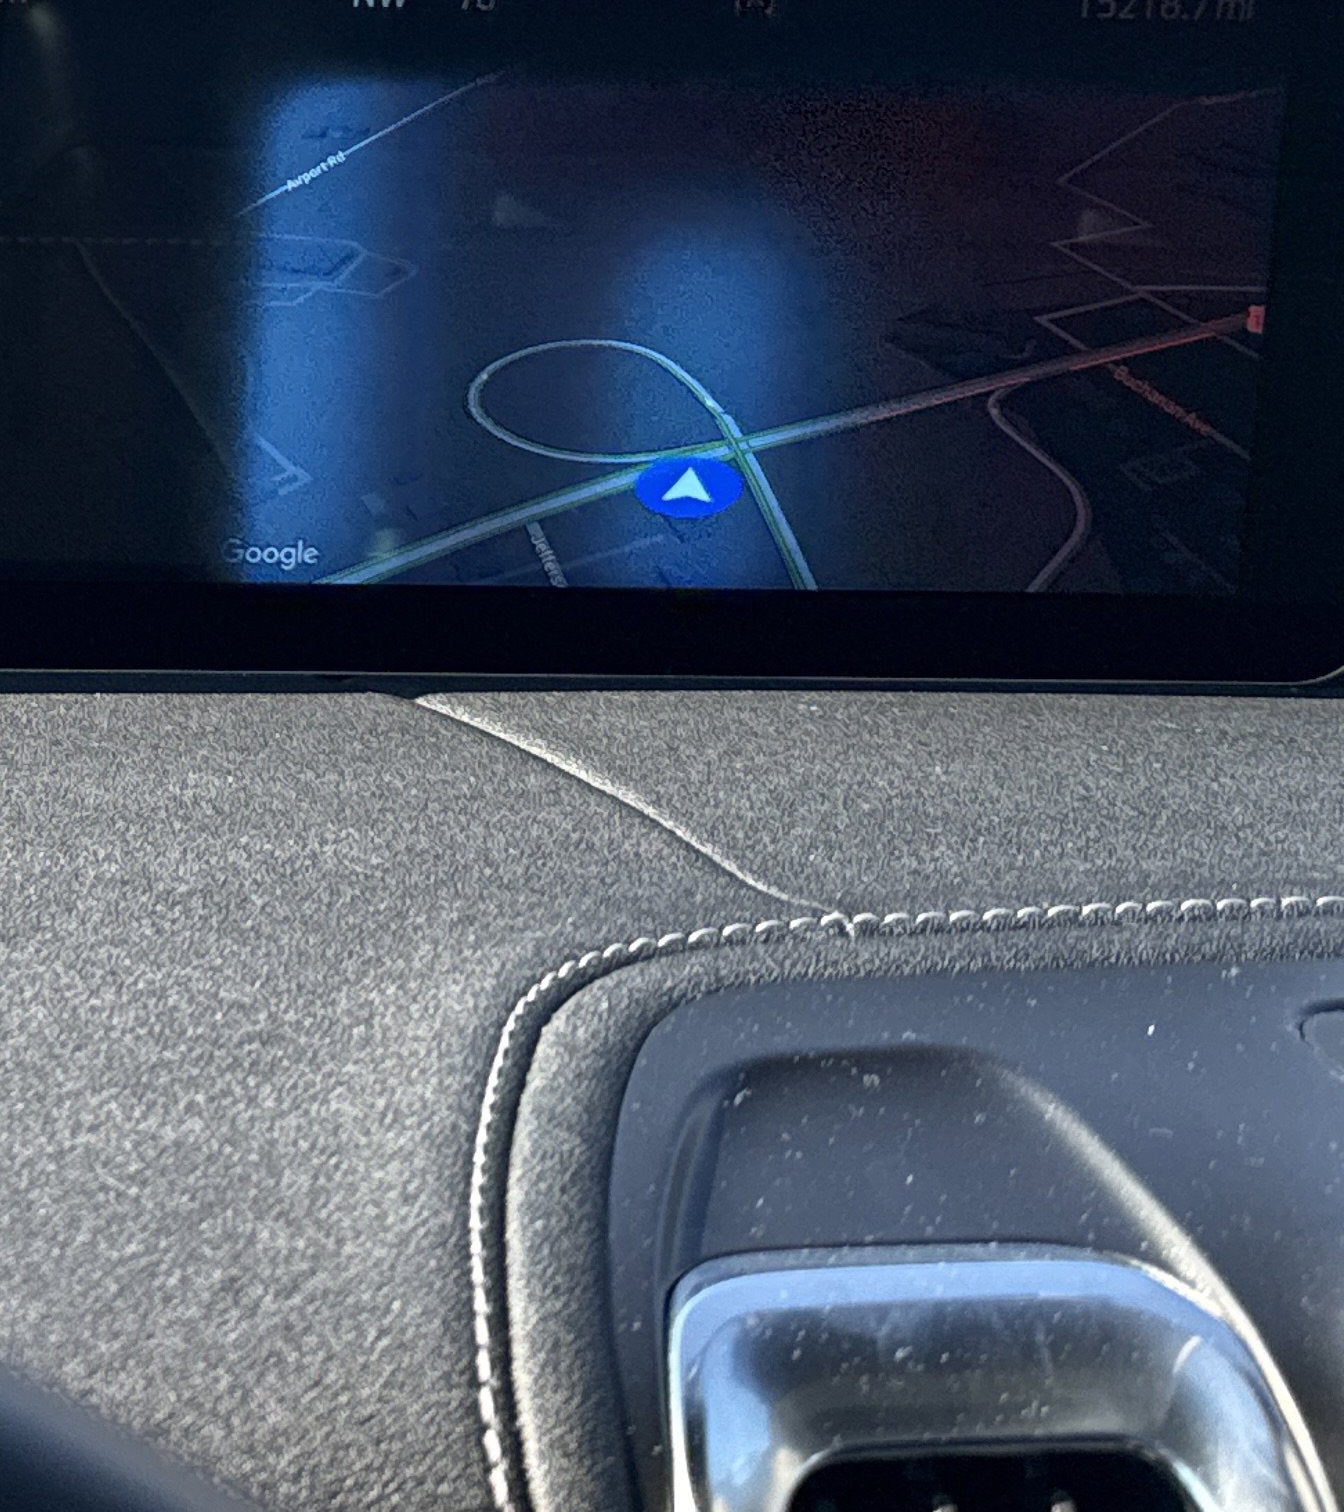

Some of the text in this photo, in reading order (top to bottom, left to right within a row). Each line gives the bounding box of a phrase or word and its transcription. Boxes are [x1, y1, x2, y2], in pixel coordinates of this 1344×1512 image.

[286, 150, 347, 192] Airport Rd
[221, 539, 320, 571] Google
[530, 536, 569, 588] Jeffers
